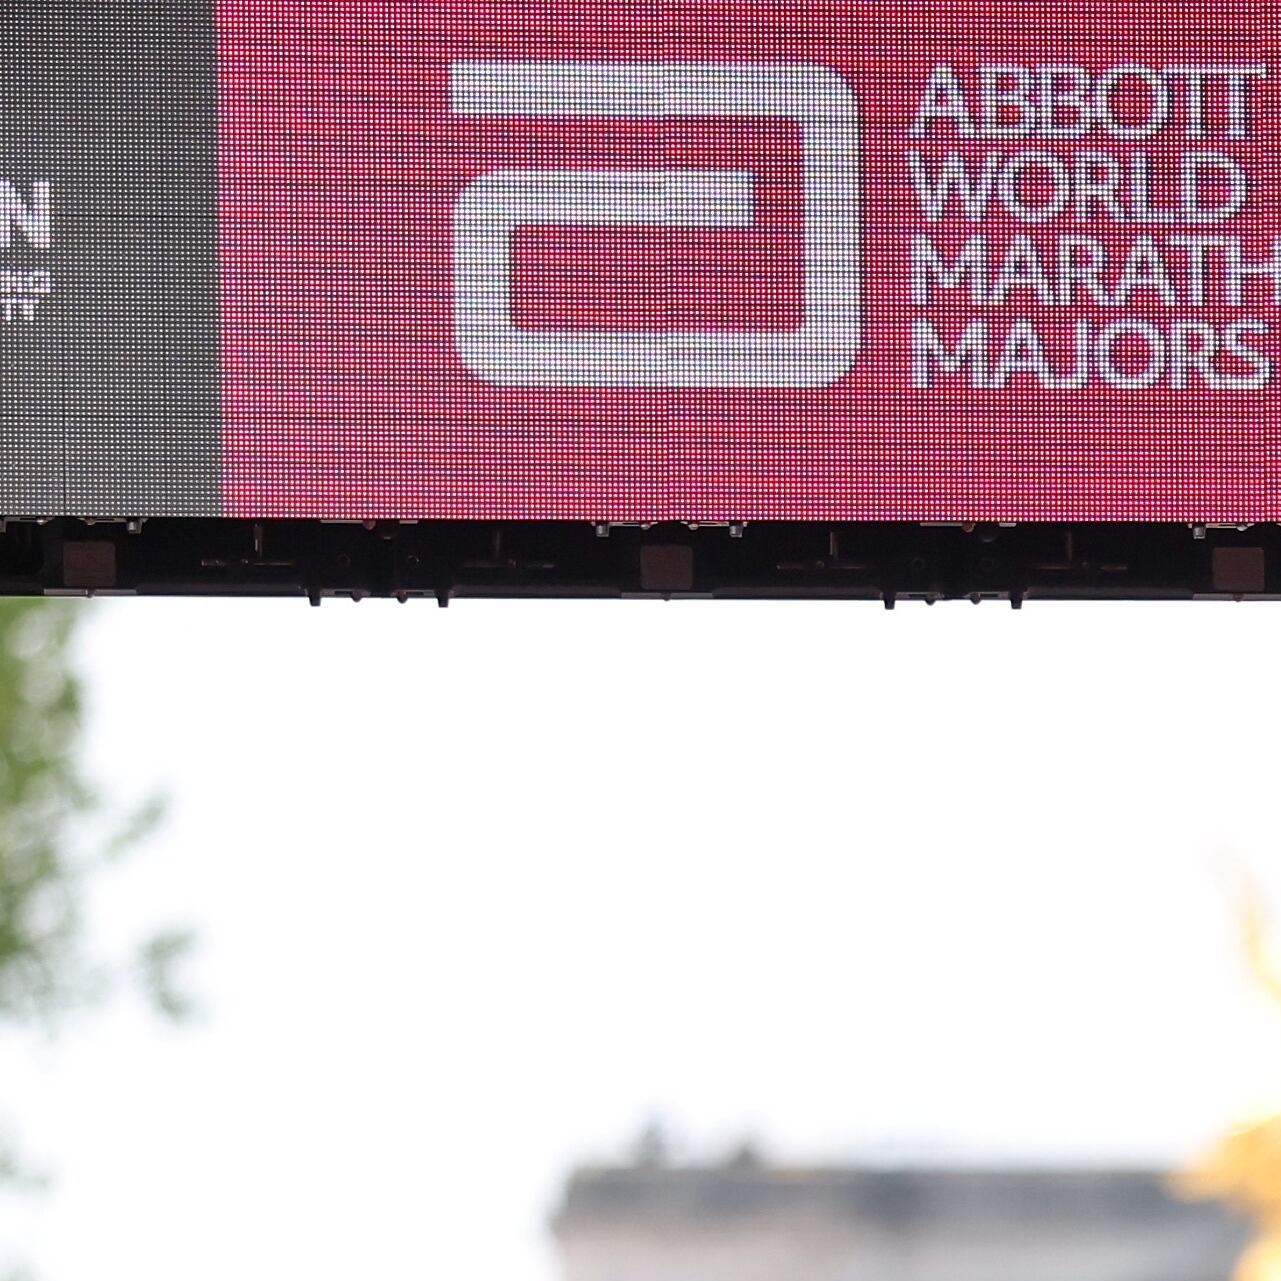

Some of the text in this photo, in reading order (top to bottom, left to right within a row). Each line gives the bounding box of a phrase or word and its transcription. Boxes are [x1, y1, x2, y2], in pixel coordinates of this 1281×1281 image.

[908, 62, 1268, 140] ABBOTT
[908, 150, 1250, 224] WORLD
[909, 318, 1276, 390] MAJORS
